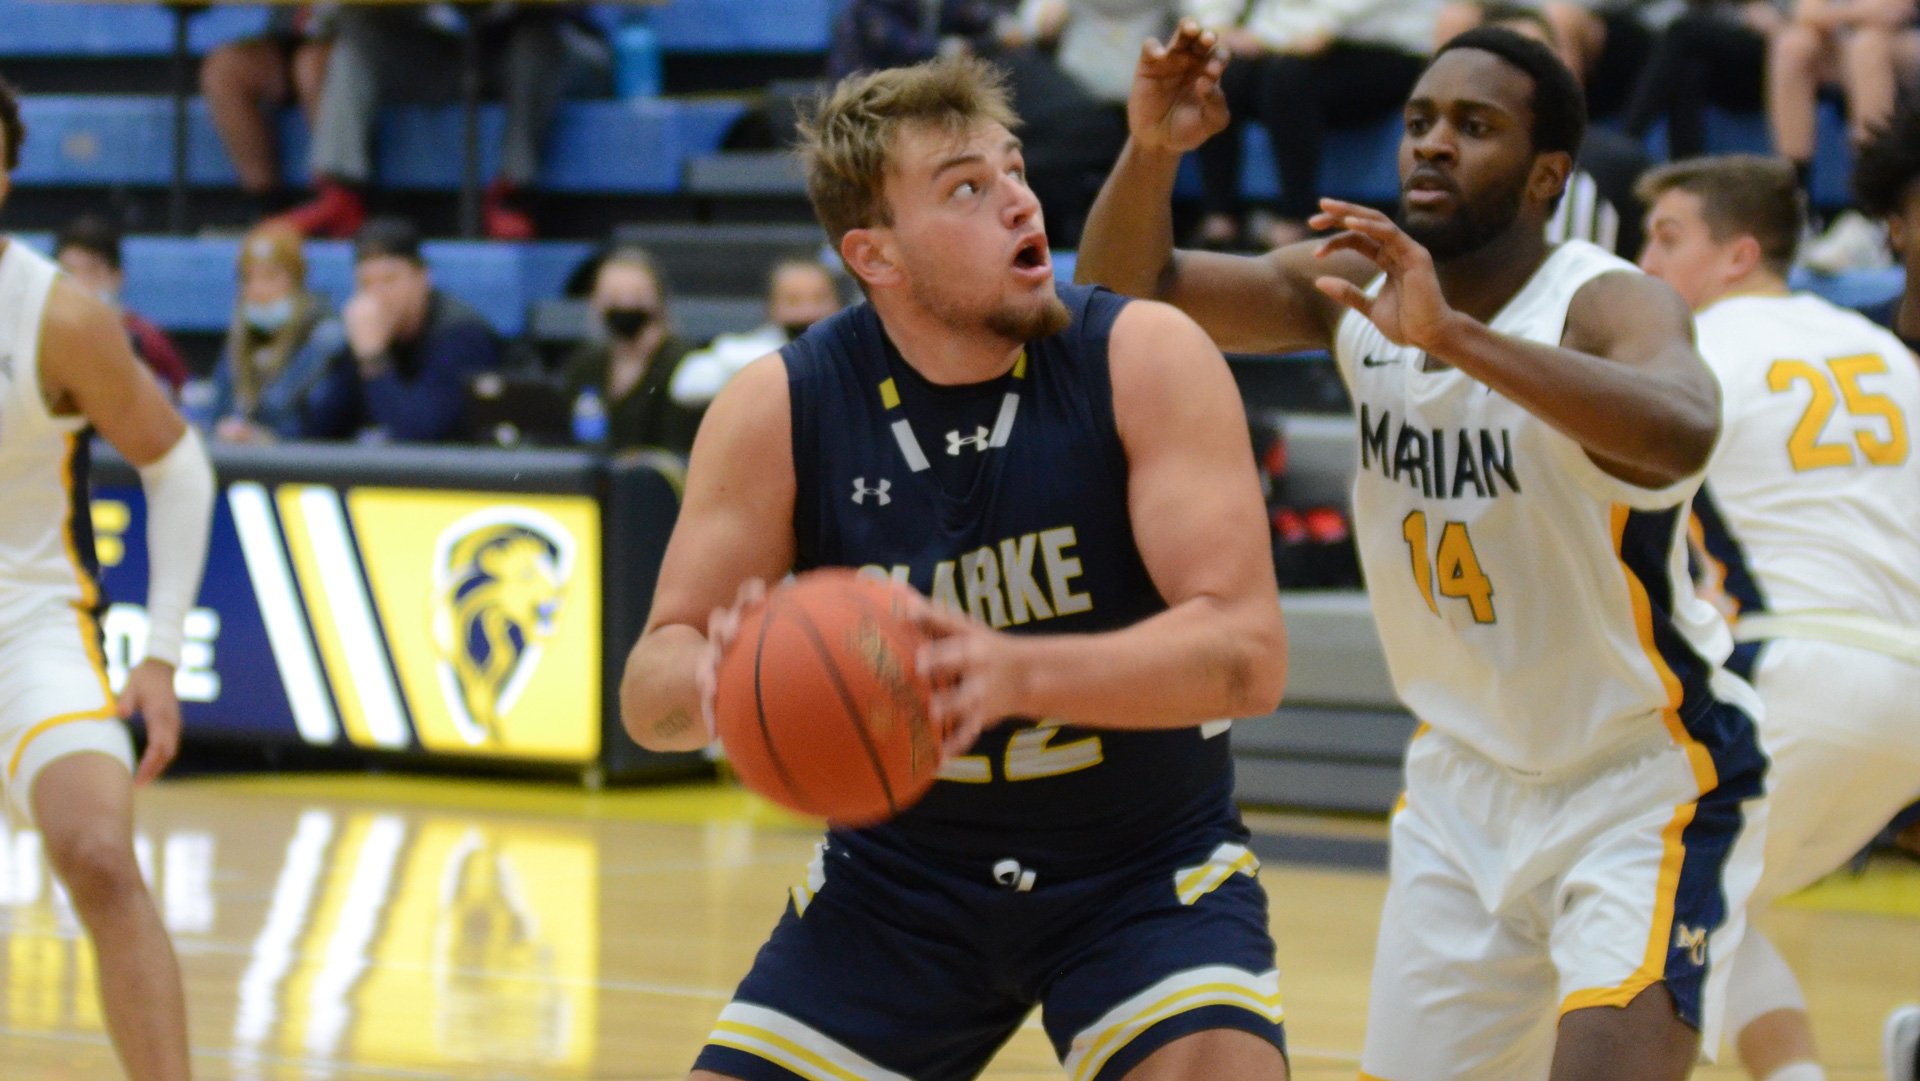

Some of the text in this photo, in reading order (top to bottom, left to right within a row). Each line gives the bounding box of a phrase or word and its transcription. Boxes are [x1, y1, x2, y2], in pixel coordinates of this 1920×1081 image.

[1361, 402, 1523, 499] MARIAN
[1766, 352, 1910, 474] 25
[855, 525, 1094, 629] ARKE
[1402, 508, 1497, 624] 14
